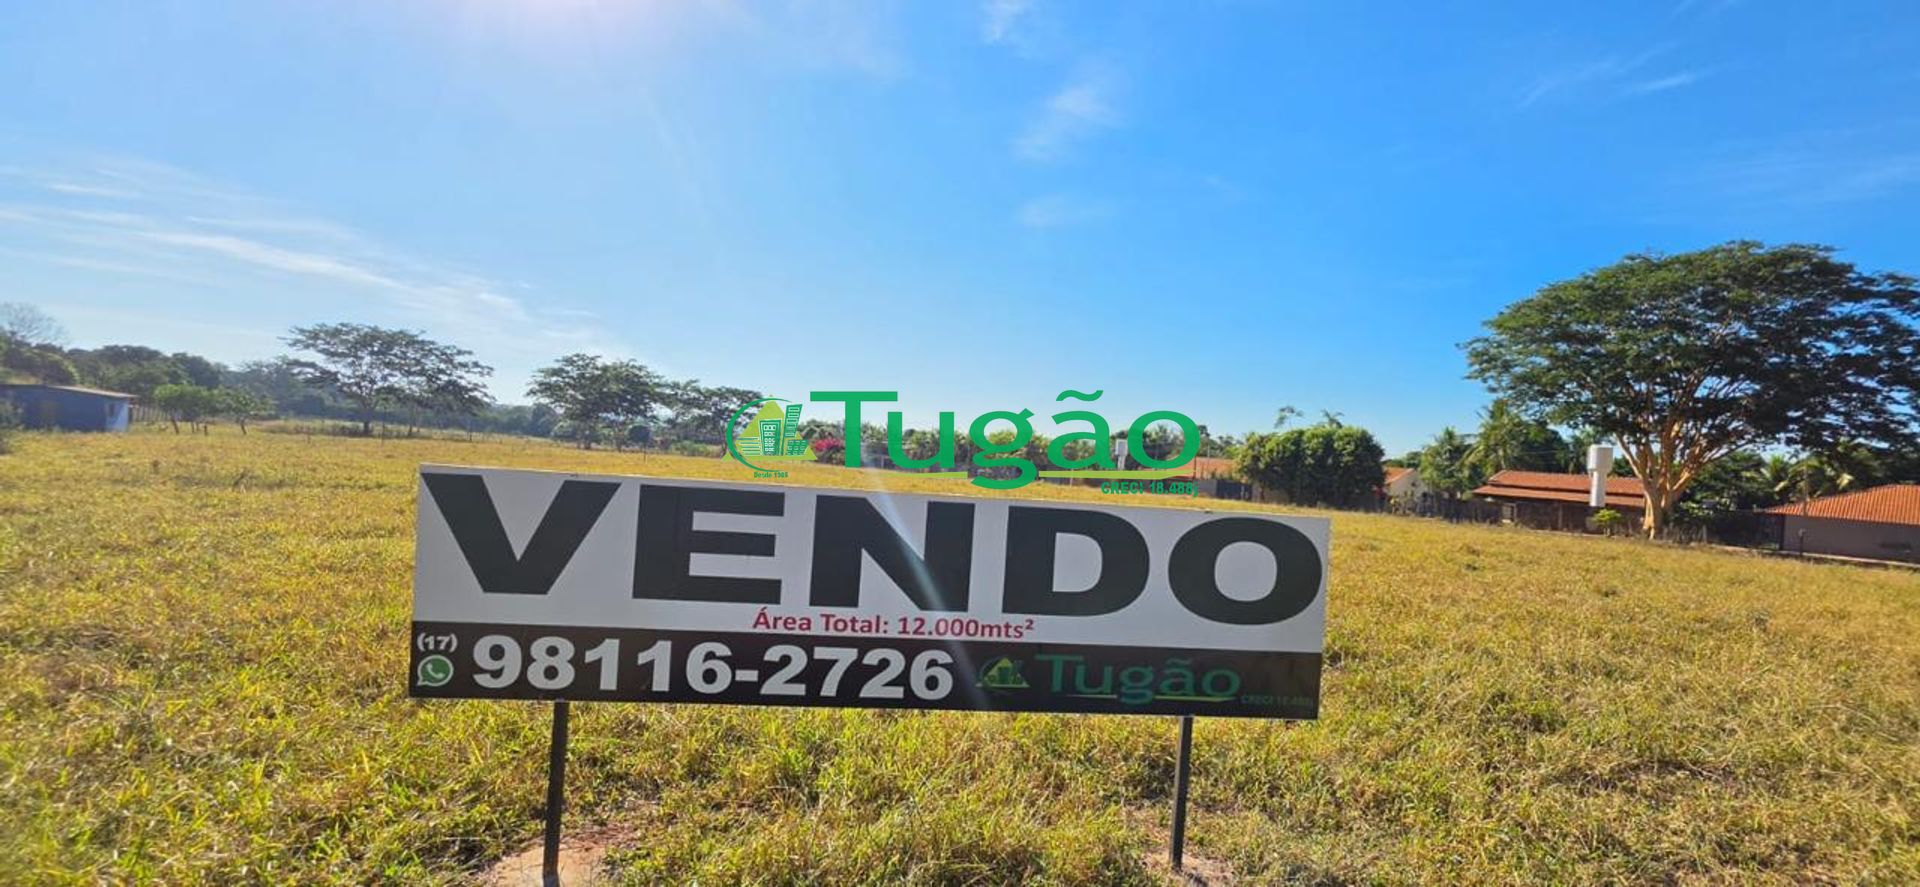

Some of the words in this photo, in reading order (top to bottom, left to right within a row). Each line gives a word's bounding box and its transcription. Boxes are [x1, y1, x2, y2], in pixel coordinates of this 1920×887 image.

[424, 474, 1322, 626] VENDO
[752, 607, 812, 631] Área
[820, 614, 888, 634] Total:
[897, 617, 1035, 639] 12.000mts²
[417, 633, 457, 651] (17)
[473, 635, 953, 701] 98116-2726
[1034, 653, 1241, 704] Tugão
